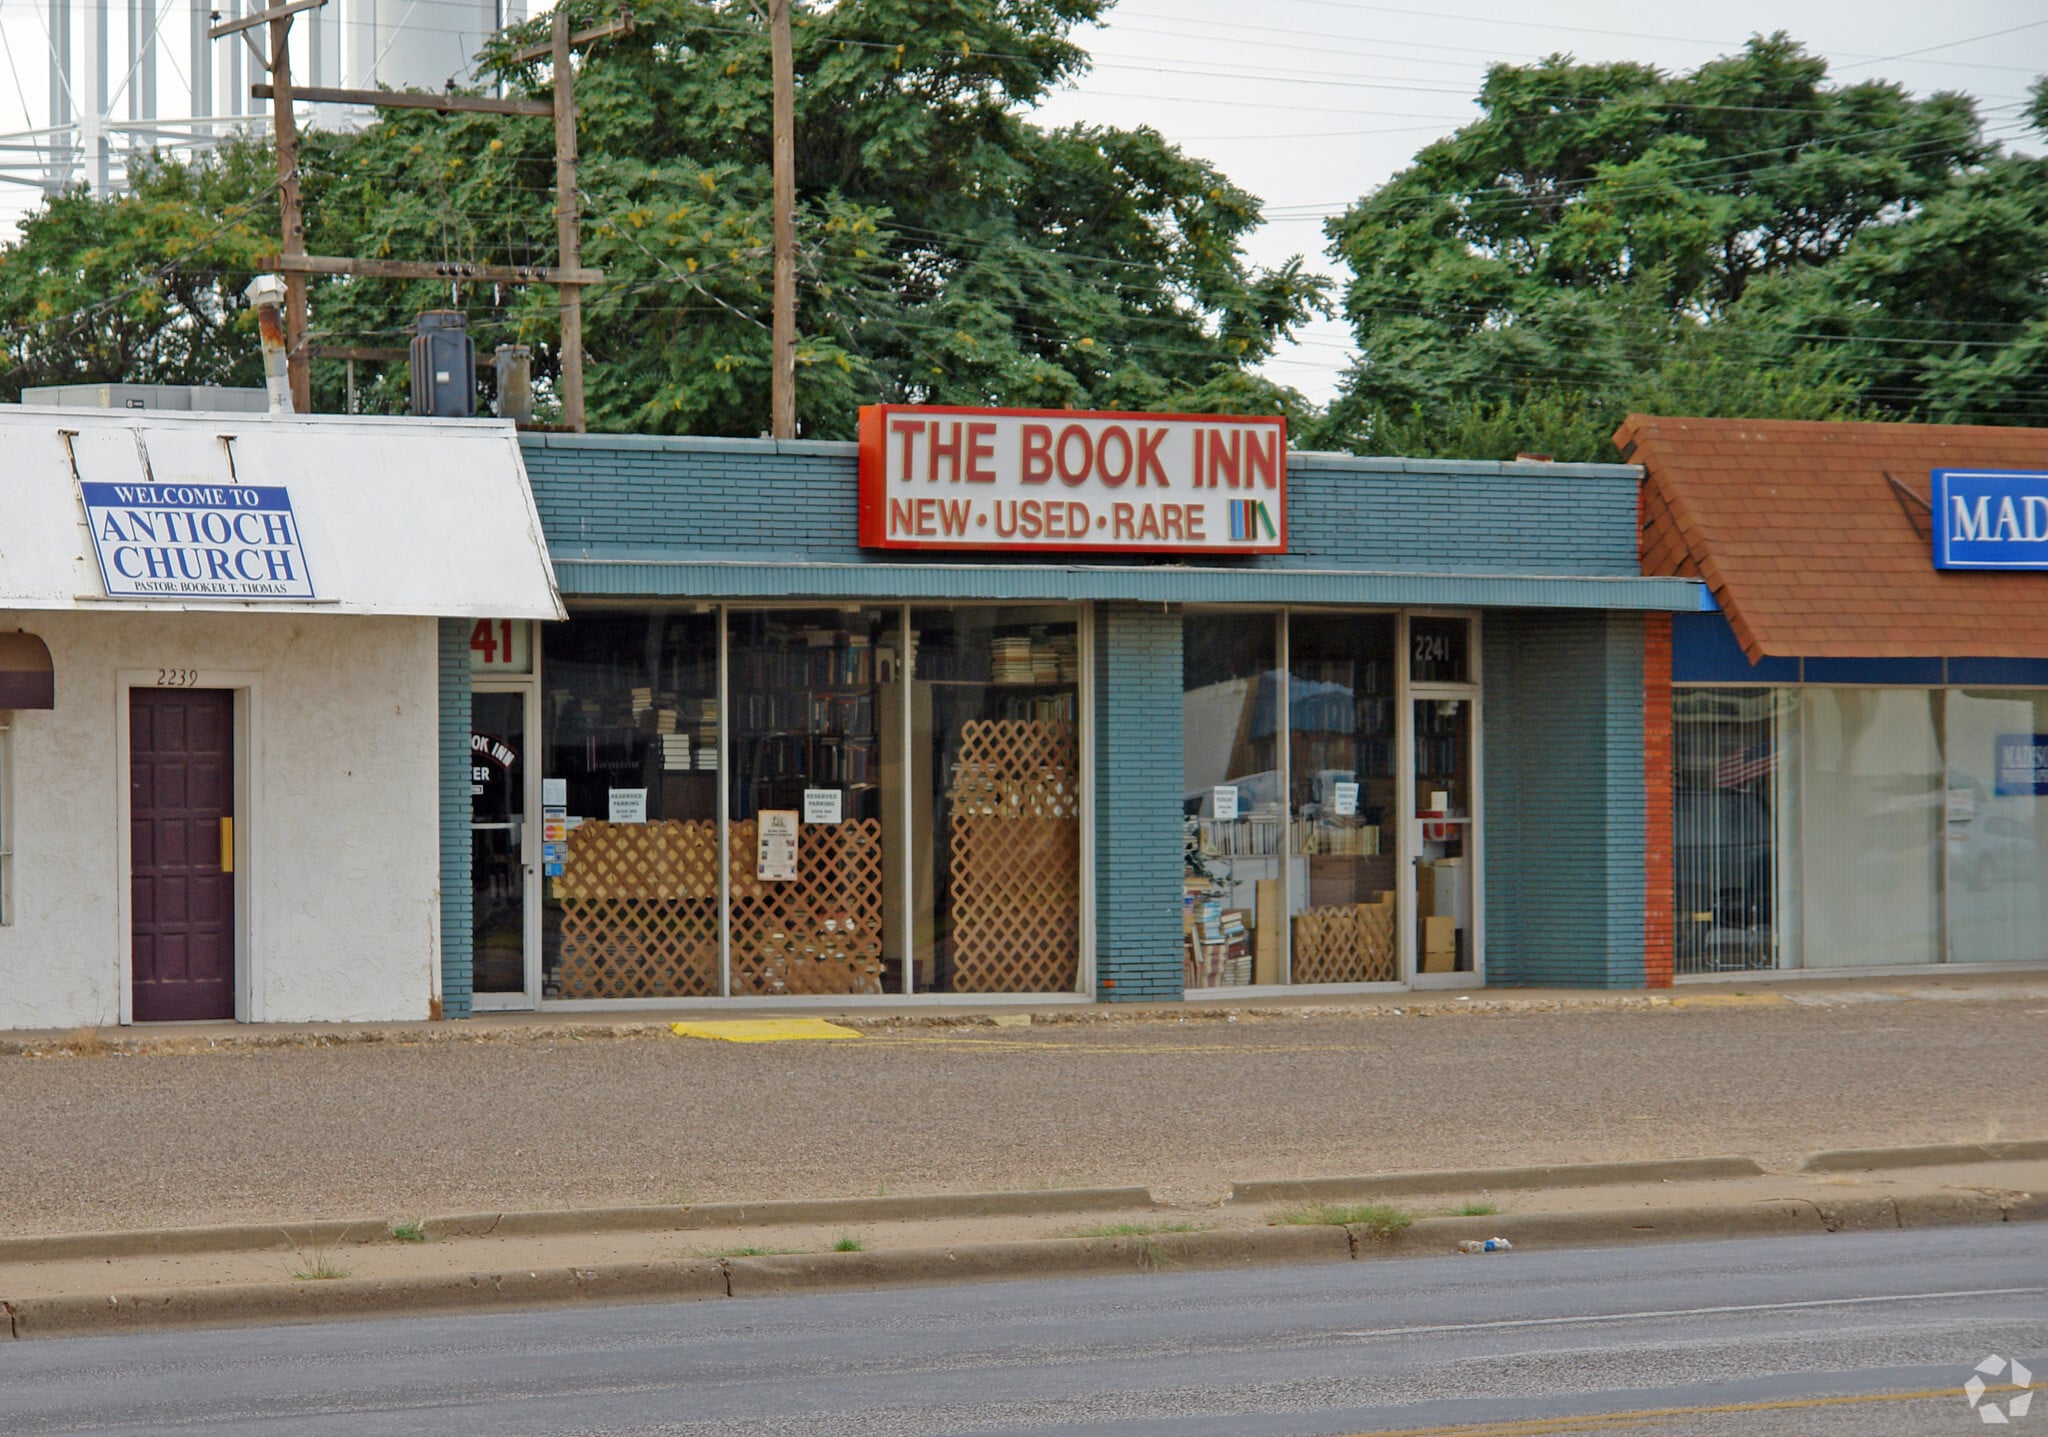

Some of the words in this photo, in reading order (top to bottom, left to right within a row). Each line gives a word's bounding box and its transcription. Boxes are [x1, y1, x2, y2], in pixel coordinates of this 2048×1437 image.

[890, 420, 997, 483] THE
[1020, 423, 1170, 488] BOOK
[1192, 428, 1277, 489] INN
[114, 486, 226, 506] WELCOME
[229, 489, 260, 507] TO
[101, 509, 296, 546] ANTIOCH
[890, 497, 972, 536] NEW
[994, 499, 1090, 538] USED
[1112, 502, 1206, 540] RARE
[1951, 495, 2048, 541] MAD
[112, 545, 298, 582] CHURCH
[134, 581, 178, 592] PASTOR:
[180, 582, 226, 593] BOOKER
[227, 583, 239, 593] T.
[242, 583, 287, 594] THOMAS
[471, 618, 512, 663] 41
[1416, 635, 1450, 661] 2241
[157, 668, 198, 687] 2239
[491, 742, 515, 767] INN
[473, 766, 490, 781] ER
